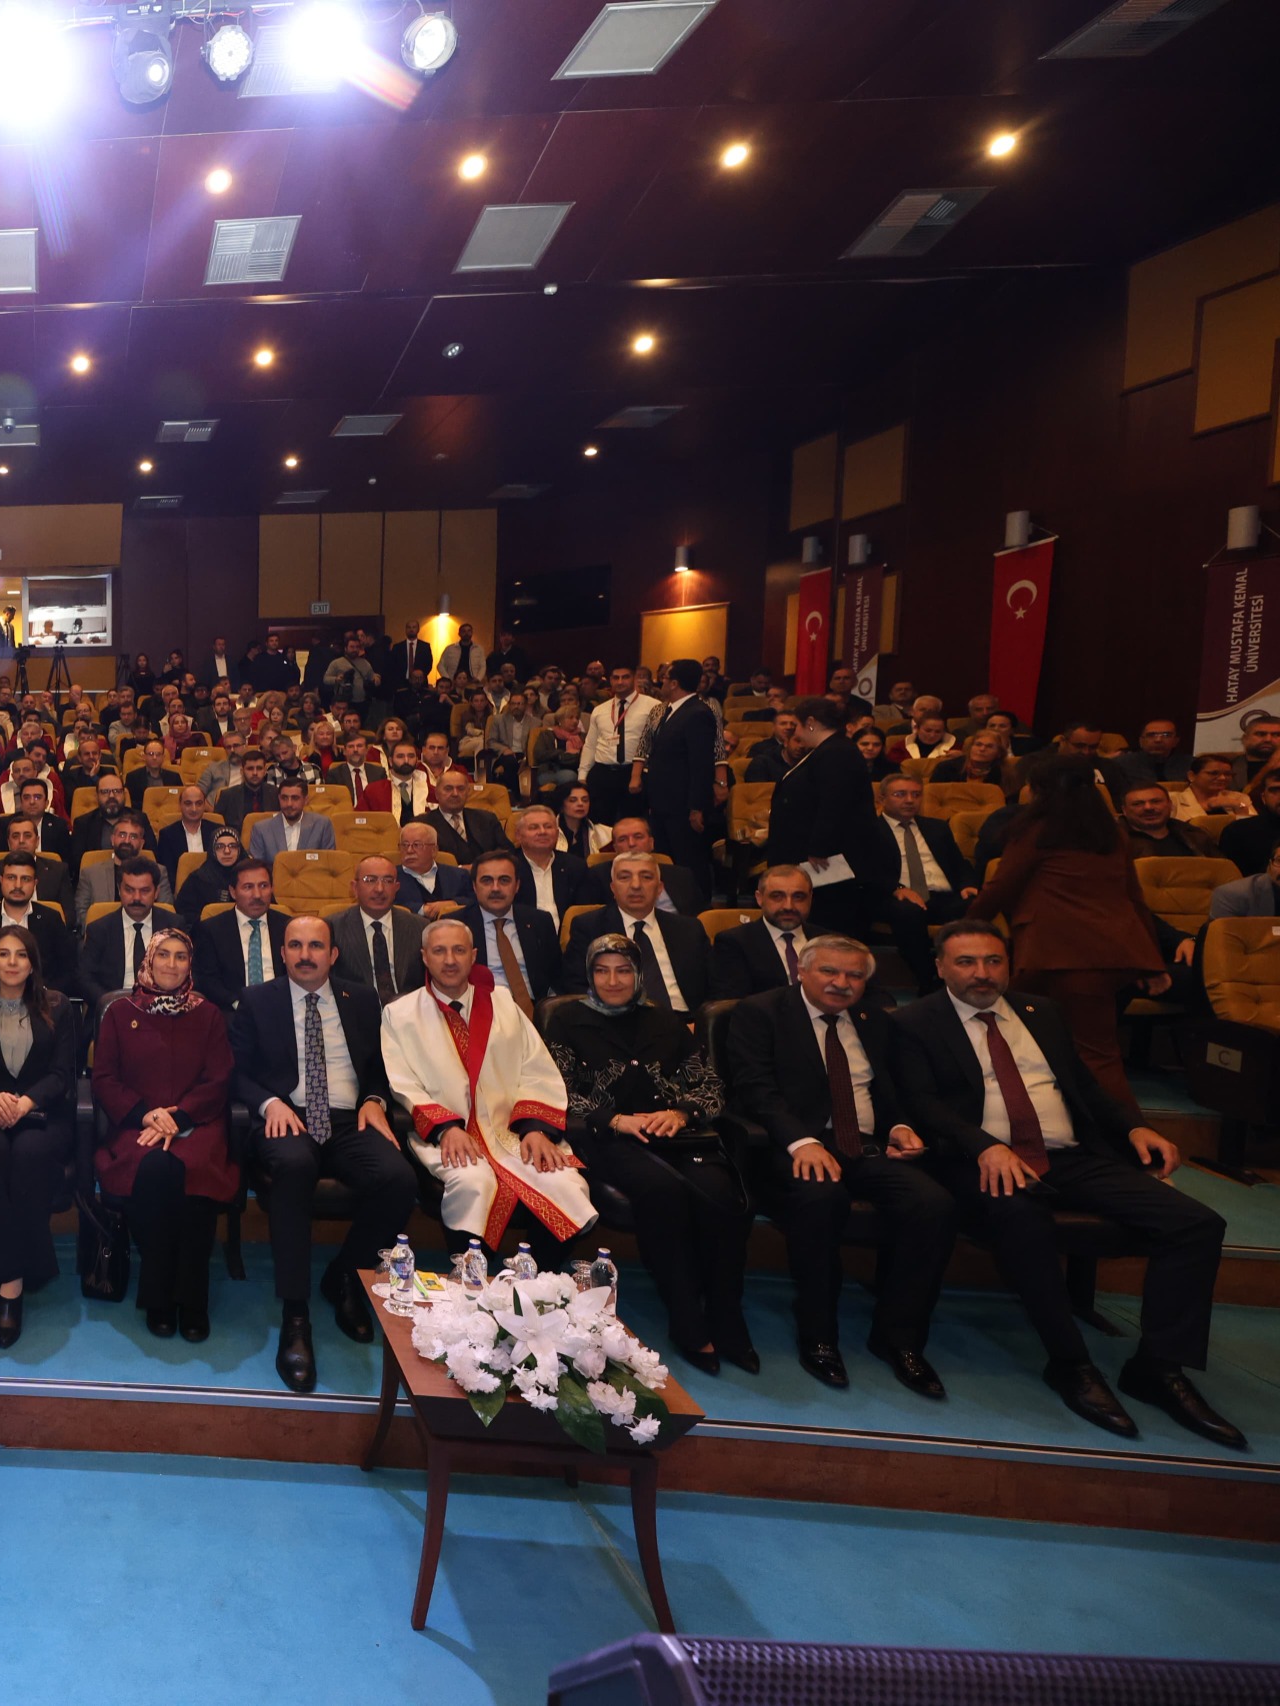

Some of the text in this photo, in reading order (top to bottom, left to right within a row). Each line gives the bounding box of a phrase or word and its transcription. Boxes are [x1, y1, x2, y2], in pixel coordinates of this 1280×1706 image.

[313, 604, 328, 613] EXIT
[1226, 567, 1248, 702] HATAY MUSTAFA KEMAL
[1243, 595, 1264, 673] ÜNİVERSİTESİ
[1218, 1050, 1231, 1066] C
